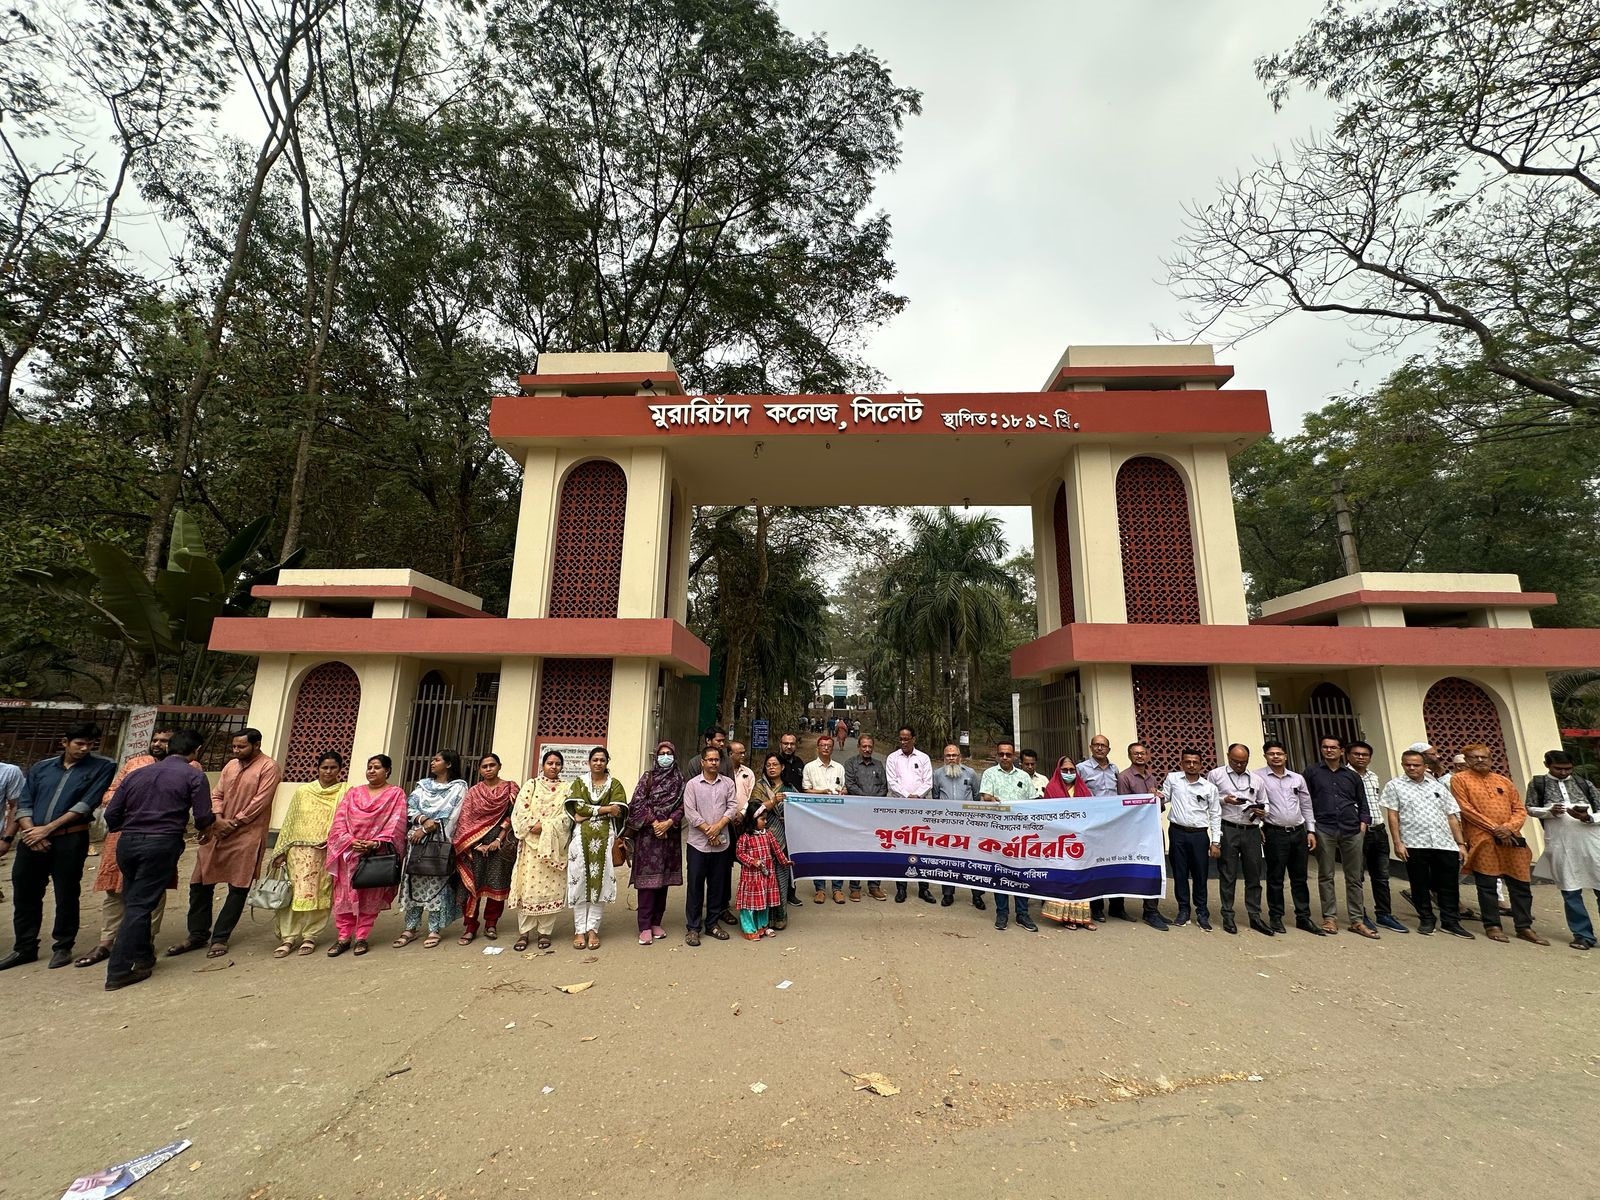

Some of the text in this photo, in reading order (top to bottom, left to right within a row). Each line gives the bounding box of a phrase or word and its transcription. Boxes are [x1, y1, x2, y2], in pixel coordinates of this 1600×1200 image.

[648, 396, 924, 430] মুরারিচাঁদ কলেজ, সিলেট
[1001, 412, 1052, 429] ১৮৯২
[925, 809, 943, 817] কর্তৃক
[977, 832, 1085, 860] কর্মবিরতি
[919, 868, 960, 880] মুরারিচাঁদ
[967, 860, 991, 871] বৈষম্য
[1022, 869, 1049, 880] পরিষদ
